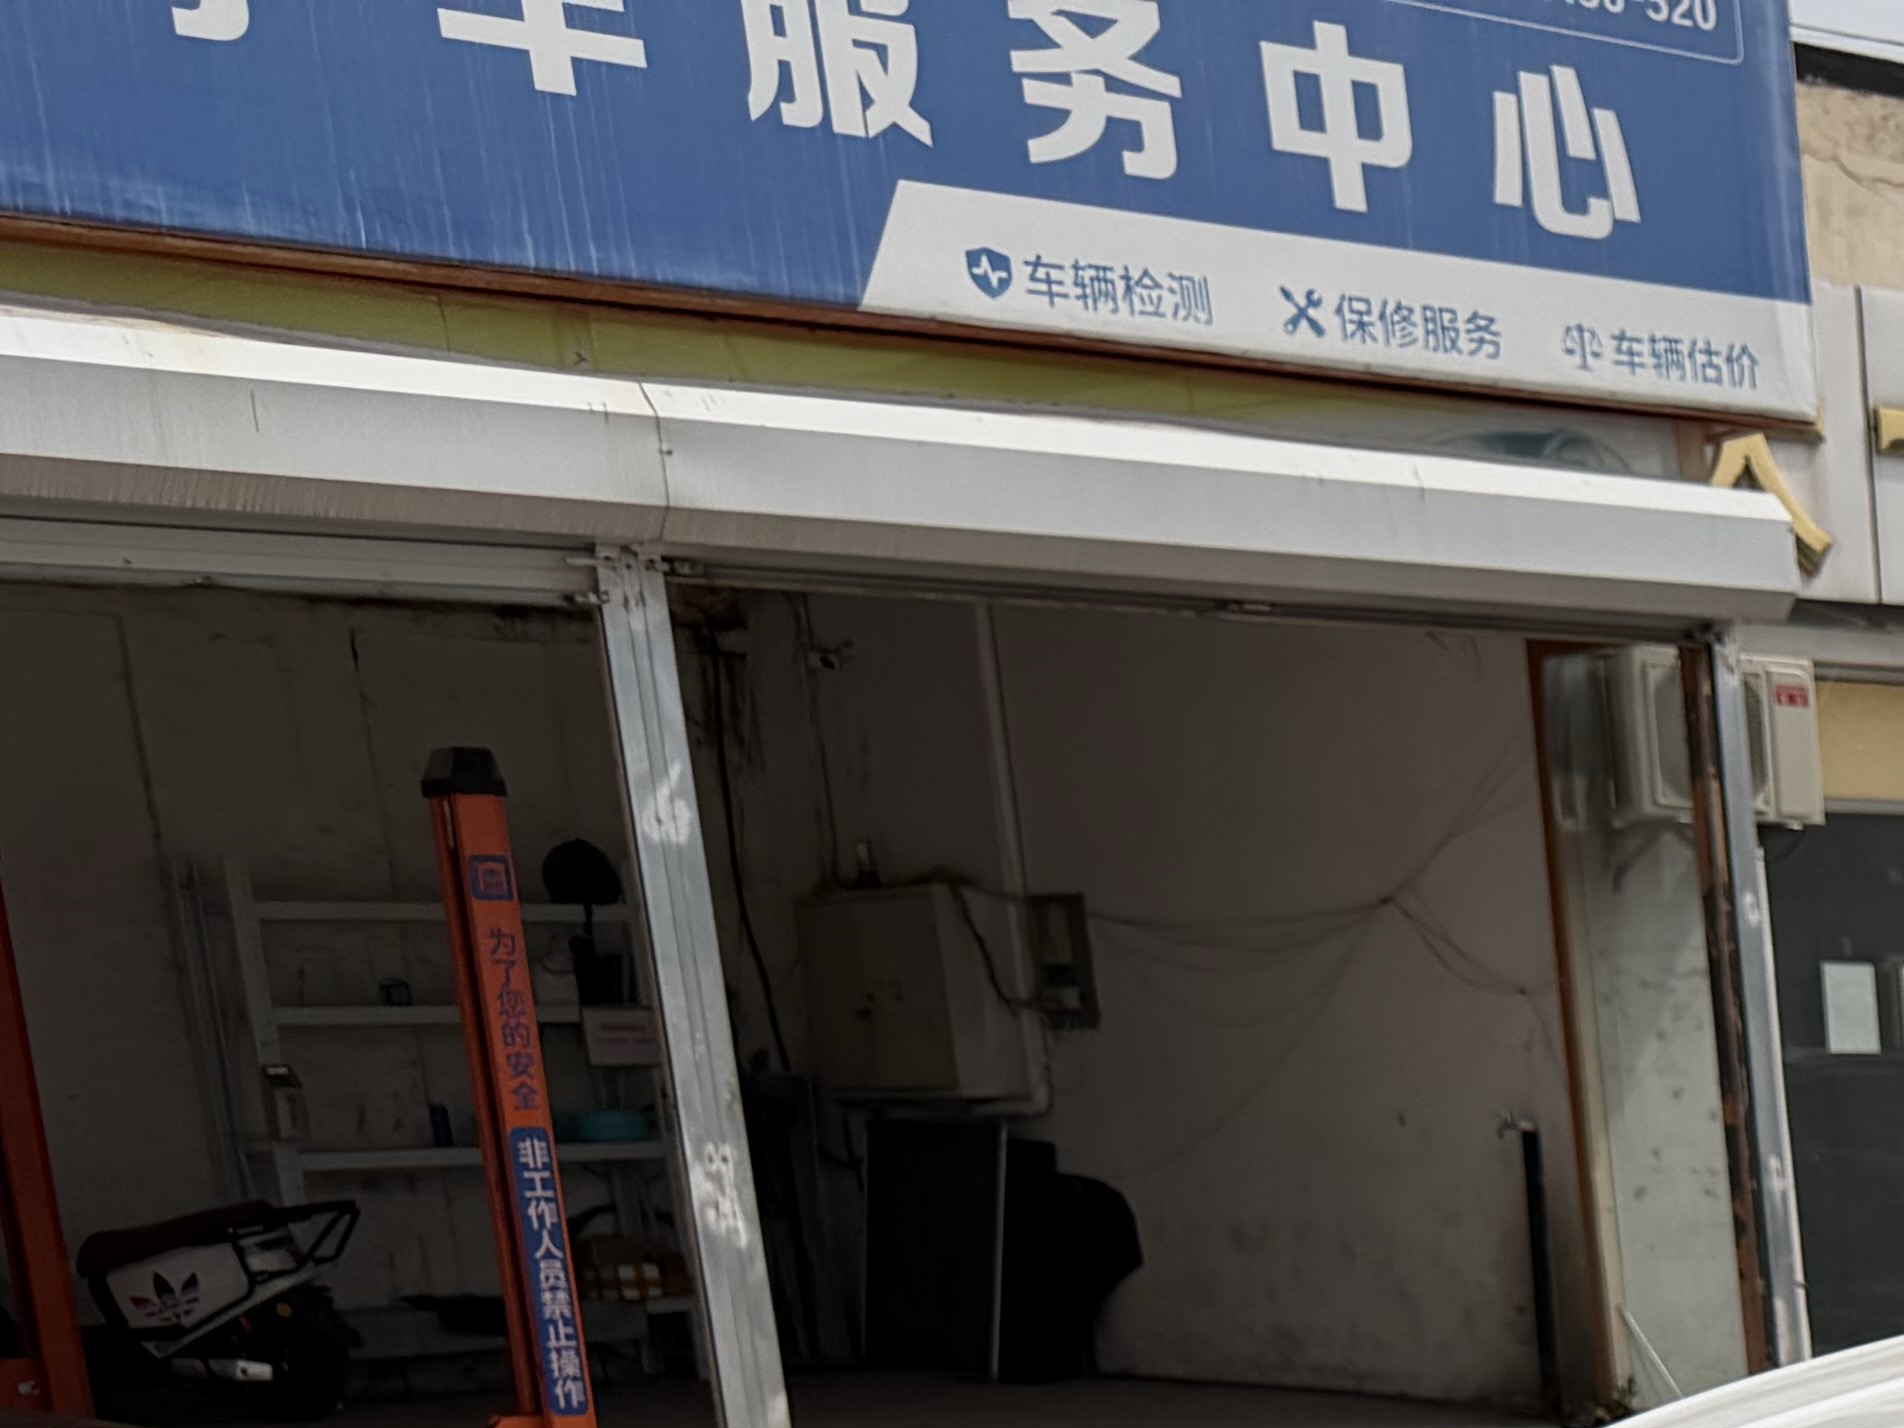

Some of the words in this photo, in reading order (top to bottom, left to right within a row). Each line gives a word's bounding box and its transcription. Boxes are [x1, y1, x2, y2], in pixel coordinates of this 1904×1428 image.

[172, 0, 1640, 238] 服务中心
[1025, 255, 1213, 326] 车辆检测
[1334, 292, 1503, 360] 保修服务
[1610, 328, 1761, 391] 车辆估价
[517, 1136, 586, 1410] 非工作人员禁止操作
